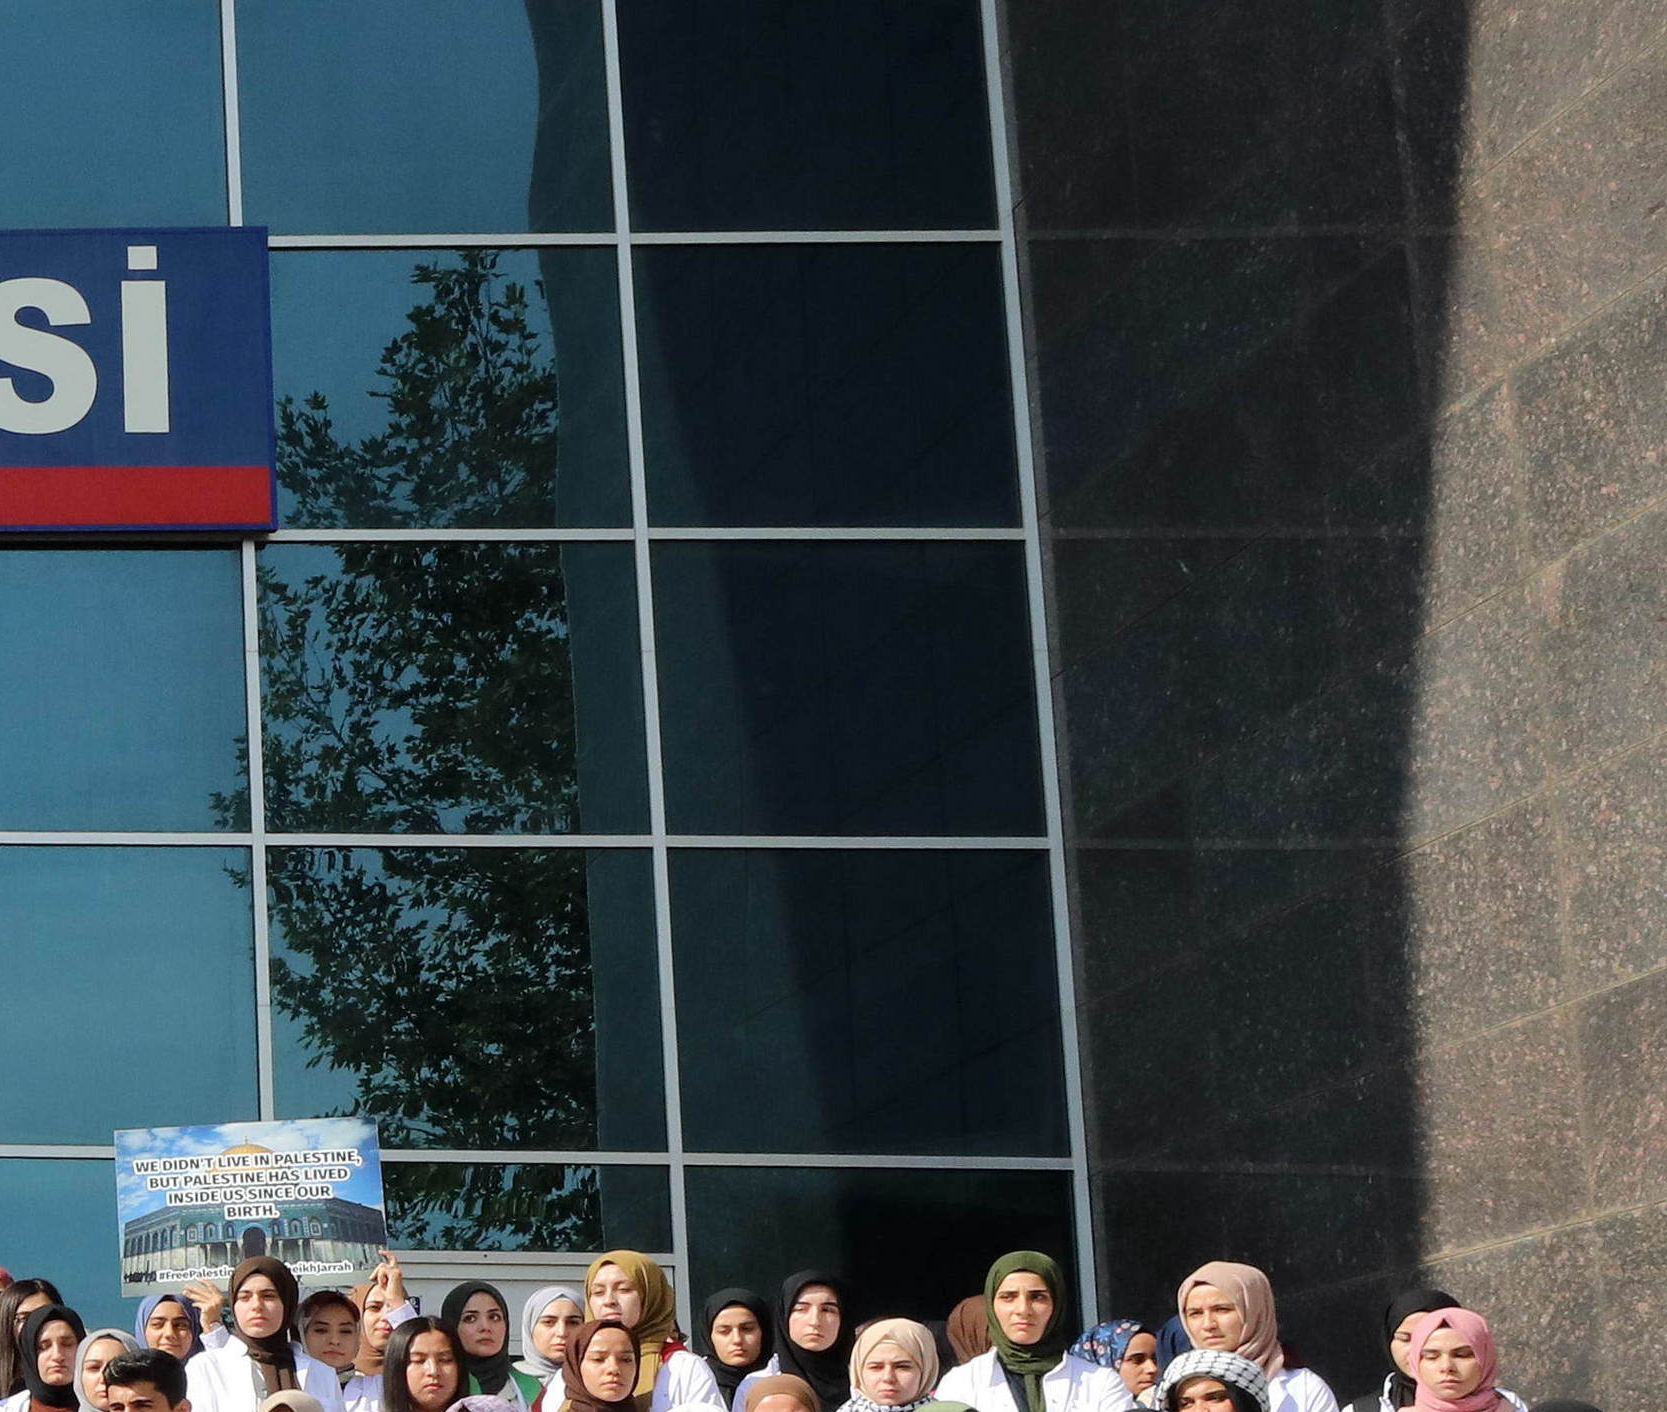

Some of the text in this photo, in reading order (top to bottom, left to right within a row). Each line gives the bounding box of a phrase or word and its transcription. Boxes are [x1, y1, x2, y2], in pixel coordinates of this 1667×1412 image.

[135, 1151, 360, 1173] WE DIDN'T LIVE IN PALESTINE,
[149, 1168, 347, 1189] BUT PALESTINE HAS LIVED
[168, 1185, 331, 1204] INSIDE US SINCE OUR
[226, 1204, 278, 1218] BIRTH.
